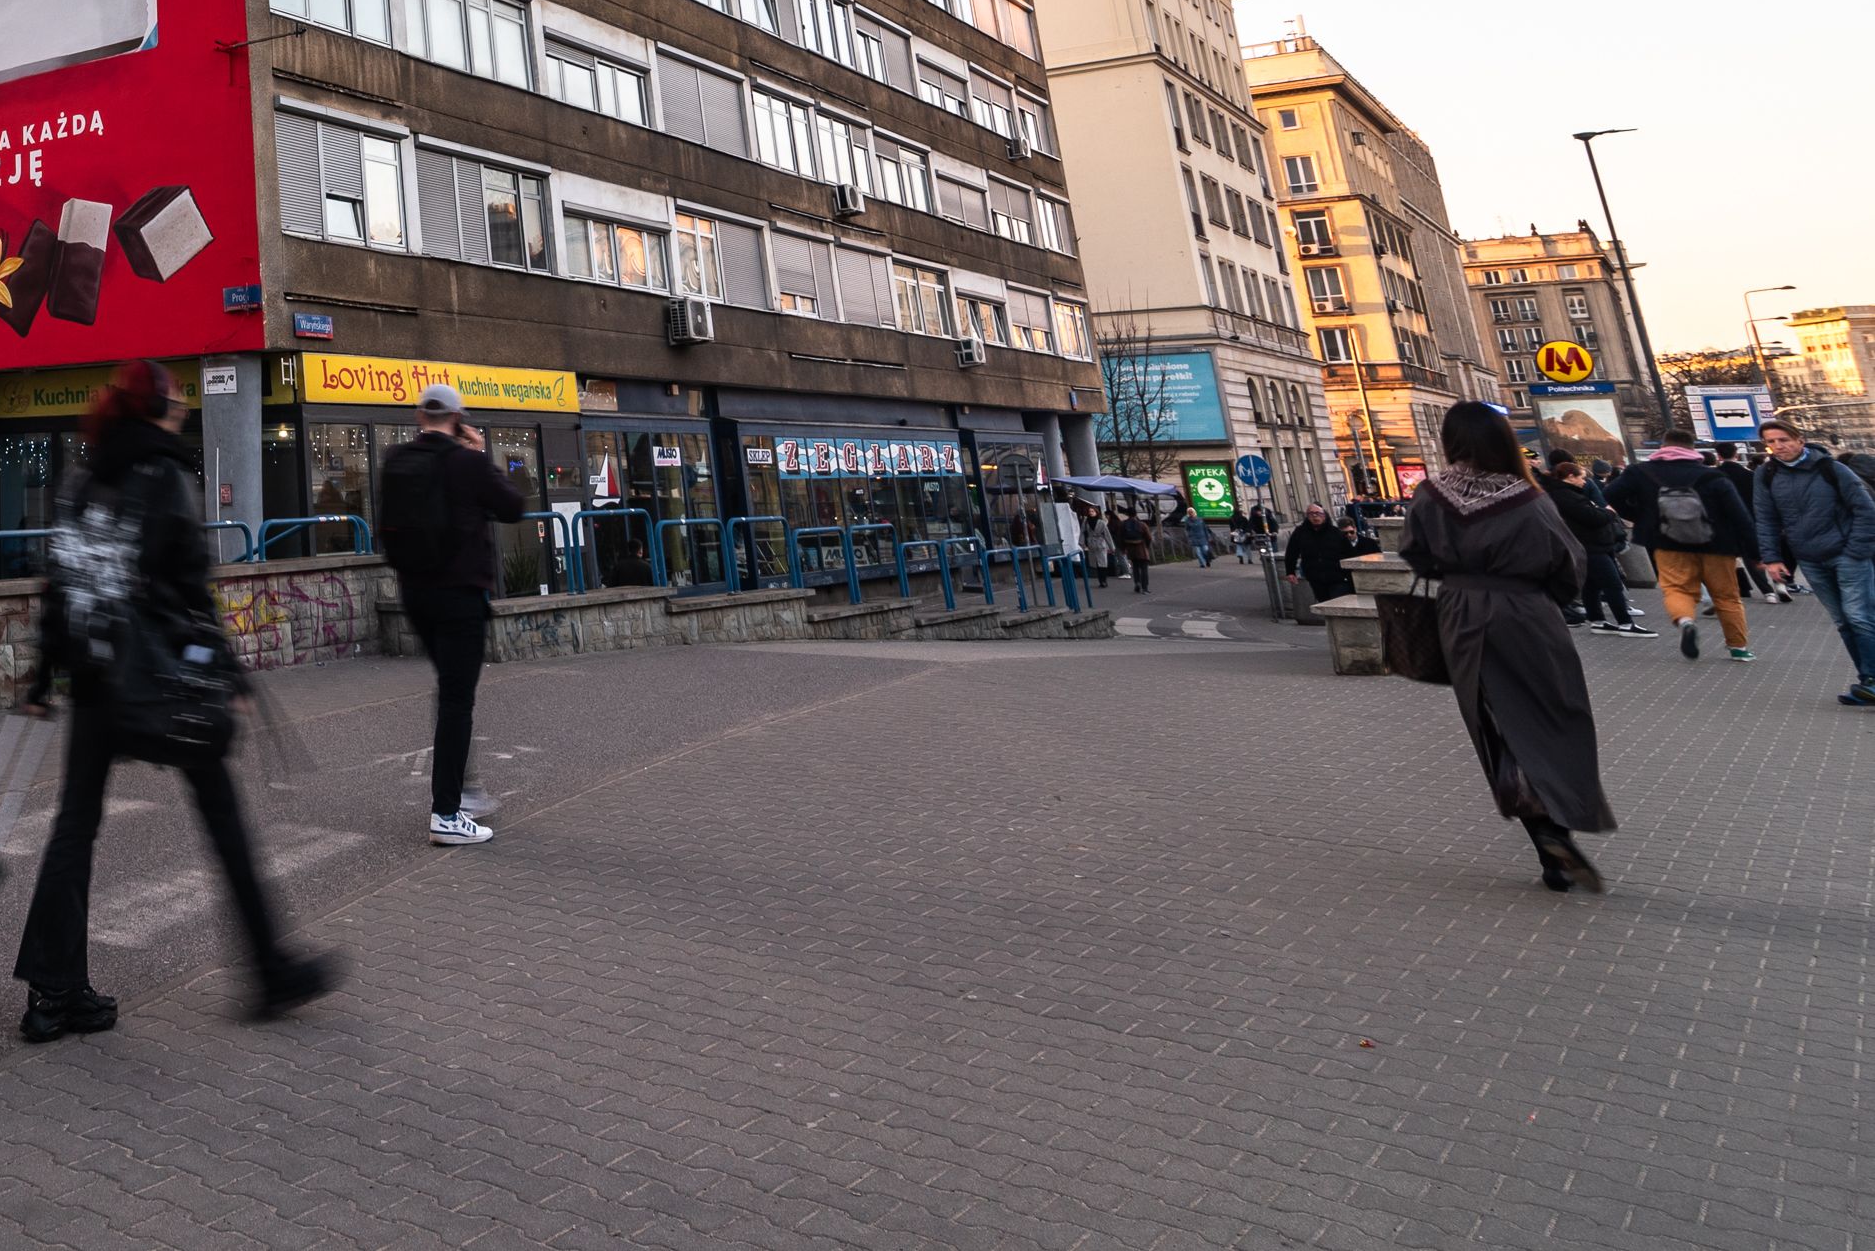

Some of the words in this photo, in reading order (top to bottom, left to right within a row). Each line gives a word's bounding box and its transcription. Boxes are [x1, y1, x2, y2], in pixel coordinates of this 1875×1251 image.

[22, 109, 105, 146] KAŻDĄ
[321, 359, 407, 402] Loving
[457, 375, 500, 398] kuchnia
[501, 379, 552, 403] wegańska
[1547, 385, 1596, 393] Politechnika
[33, 384, 99, 407] Kuchnia
[748, 450, 771, 463] SKLEP
[1188, 468, 1227, 477] APTEKA
[825, 549, 864, 560] MUO
